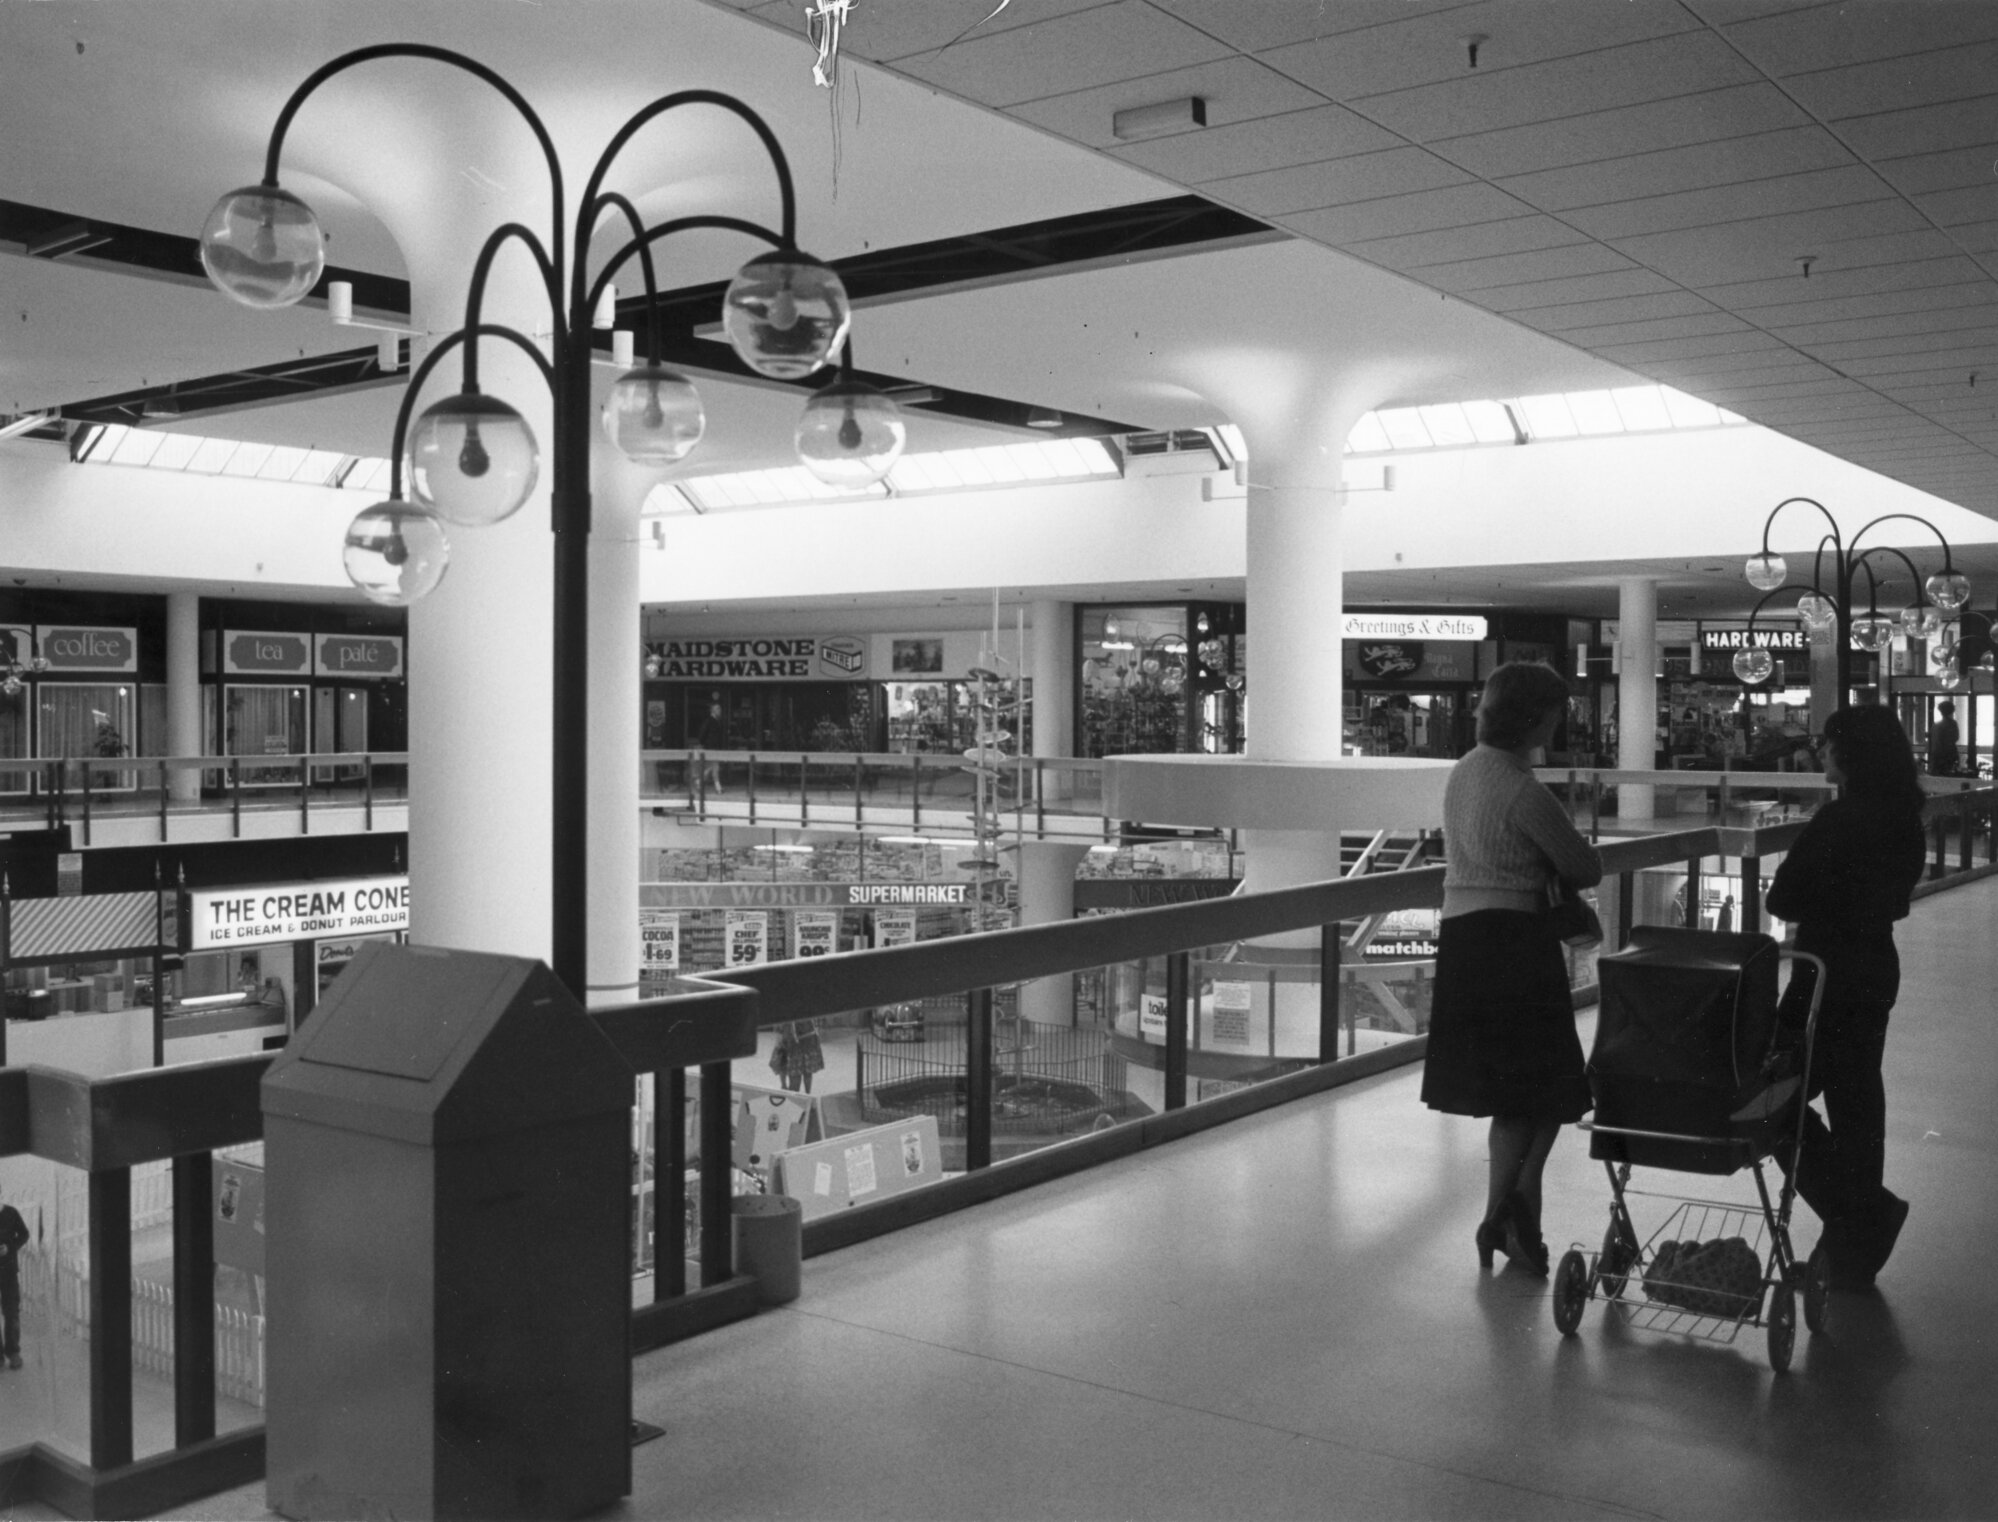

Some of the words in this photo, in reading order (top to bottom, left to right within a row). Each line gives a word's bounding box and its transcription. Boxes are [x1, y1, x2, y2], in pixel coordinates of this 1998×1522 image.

[1345, 618, 1415, 636] Greetings
[1418, 619, 1431, 635] &
[1436, 619, 1475, 635] Gifts
[53, 631, 121, 657] coffee
[254, 640, 283, 661] tea
[645, 639, 815, 658] MAIDSTONE
[826, 648, 851, 669] MITRE
[210, 898, 256, 924] THE
[262, 891, 345, 920] CREAM
[353, 886, 410, 911] CONE
[650, 886, 714, 905] NEW
[730, 886, 834, 905] WORLD
[849, 884, 967, 904] SUPERMARKET
[210, 928, 231, 940] ICE
[236, 923, 283, 938] CREAM
[288, 922, 296, 933] &
[301, 918, 344, 932] DONUT
[349, 912, 406, 927] PARLOUR
[642, 930, 674, 941] COCOA
[734, 930, 759, 938] CHEF
[1365, 940, 1439, 955] matchb
